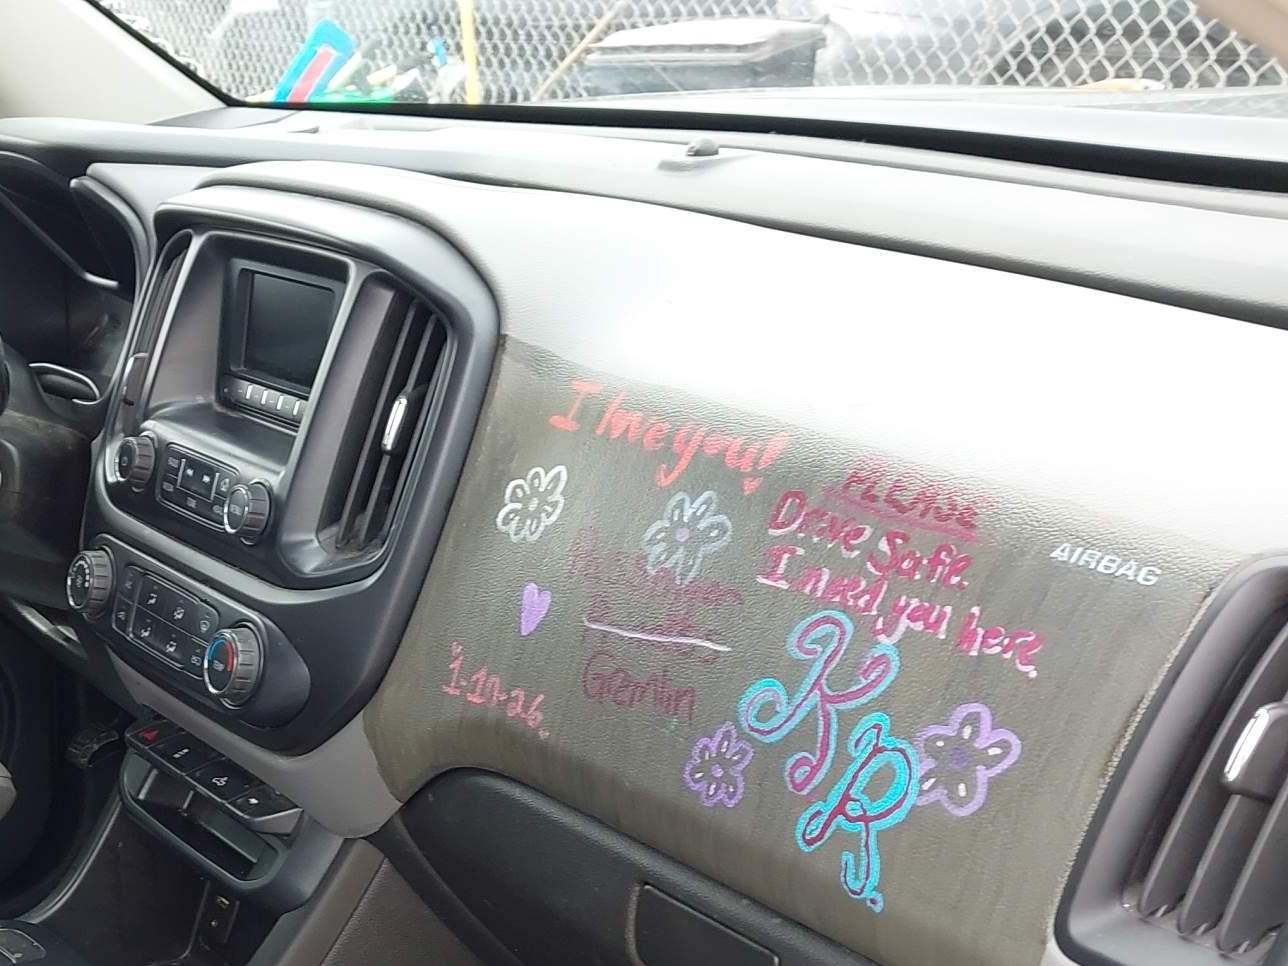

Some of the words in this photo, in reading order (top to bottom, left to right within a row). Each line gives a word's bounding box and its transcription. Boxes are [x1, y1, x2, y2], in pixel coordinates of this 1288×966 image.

[549, 380, 602, 431] I
[767, 489, 874, 559] Drive
[1049, 542, 1162, 586] AIRBAG
[756, 545, 805, 590] I
[796, 567, 889, 616] need
[872, 595, 953, 646] you
